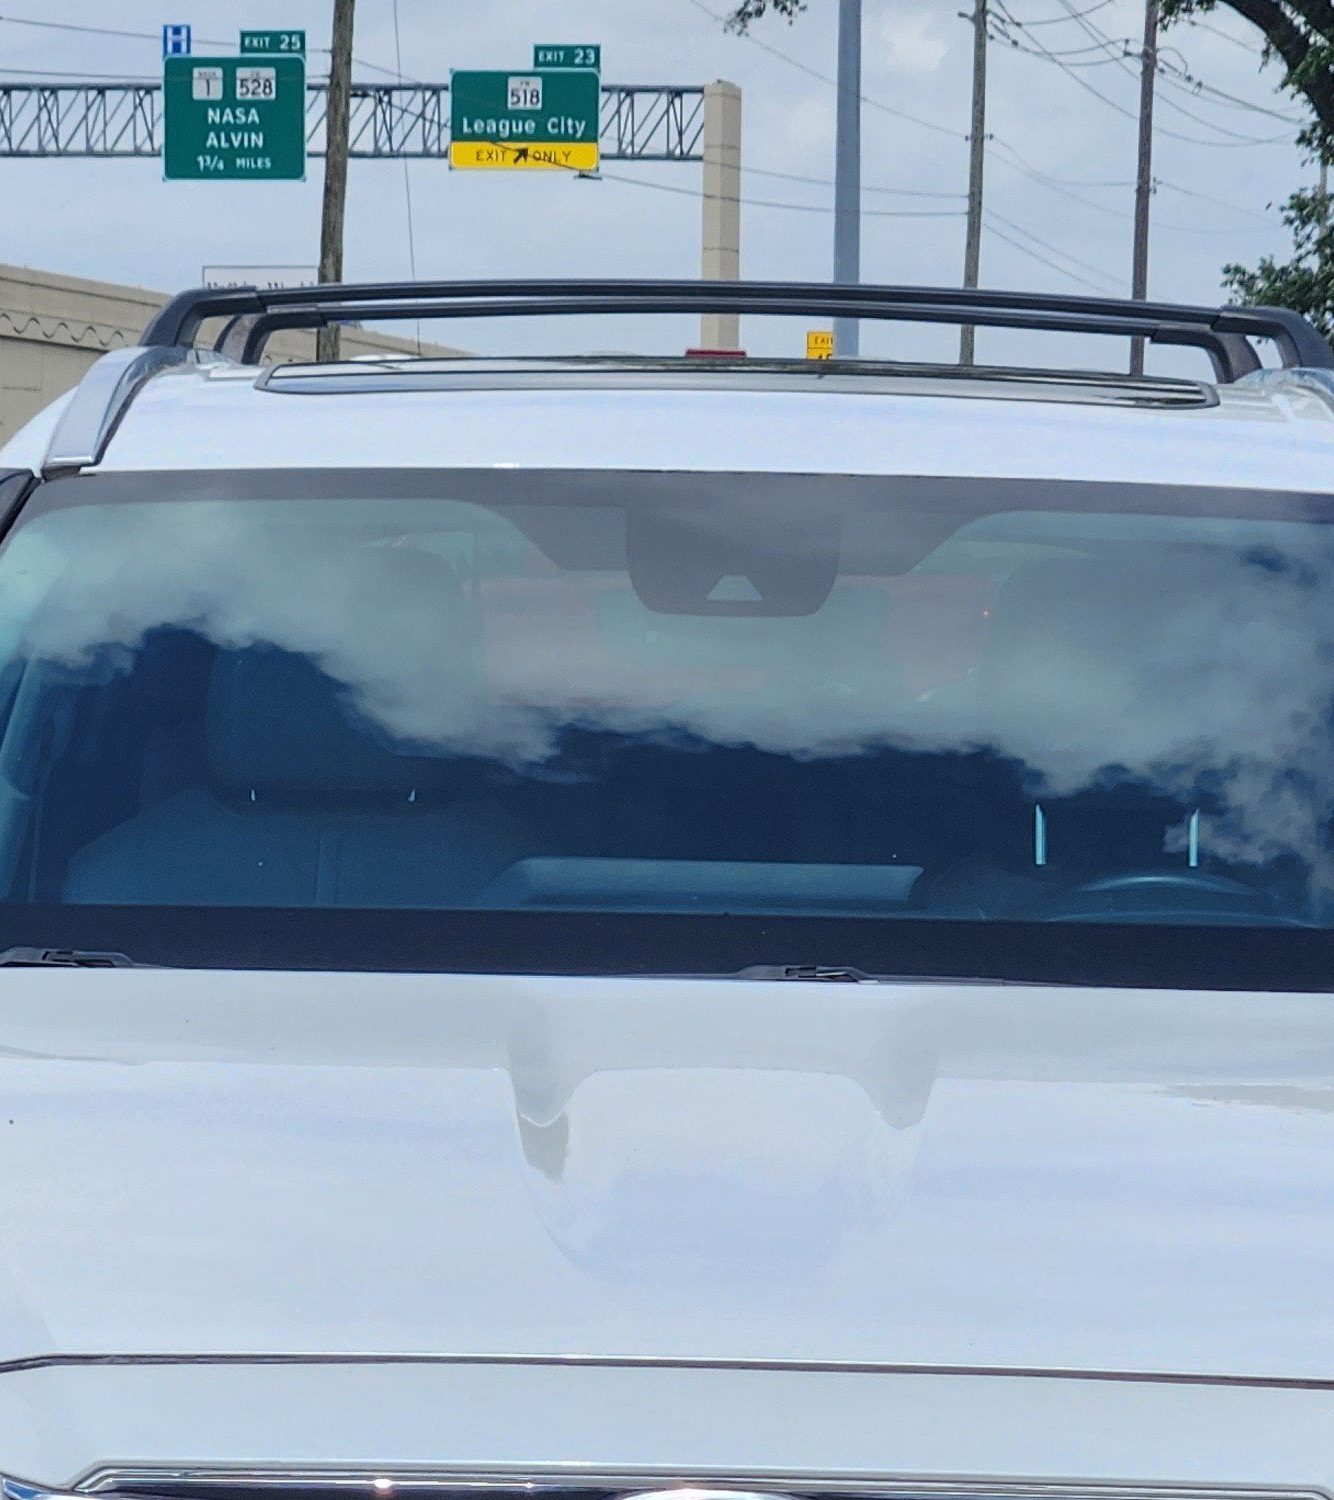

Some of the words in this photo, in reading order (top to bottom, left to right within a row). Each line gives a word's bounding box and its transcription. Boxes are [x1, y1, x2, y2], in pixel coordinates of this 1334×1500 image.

[244, 35, 271, 48] EXIT
[279, 34, 301, 50] 25
[538, 50, 565, 63] EXIT
[574, 48, 595, 64] 23
[205, 79, 210, 96] 1
[239, 79, 273, 96] 528
[510, 89, 540, 106] 518
[208, 107, 260, 124] NASA
[462, 117, 536, 137] League
[547, 116, 586, 138] City
[206, 131, 264, 149] ALVIN
[236, 157, 272, 169] MILES
[476, 150, 507, 161] EXIT
[533, 150, 571, 162] ONLY
